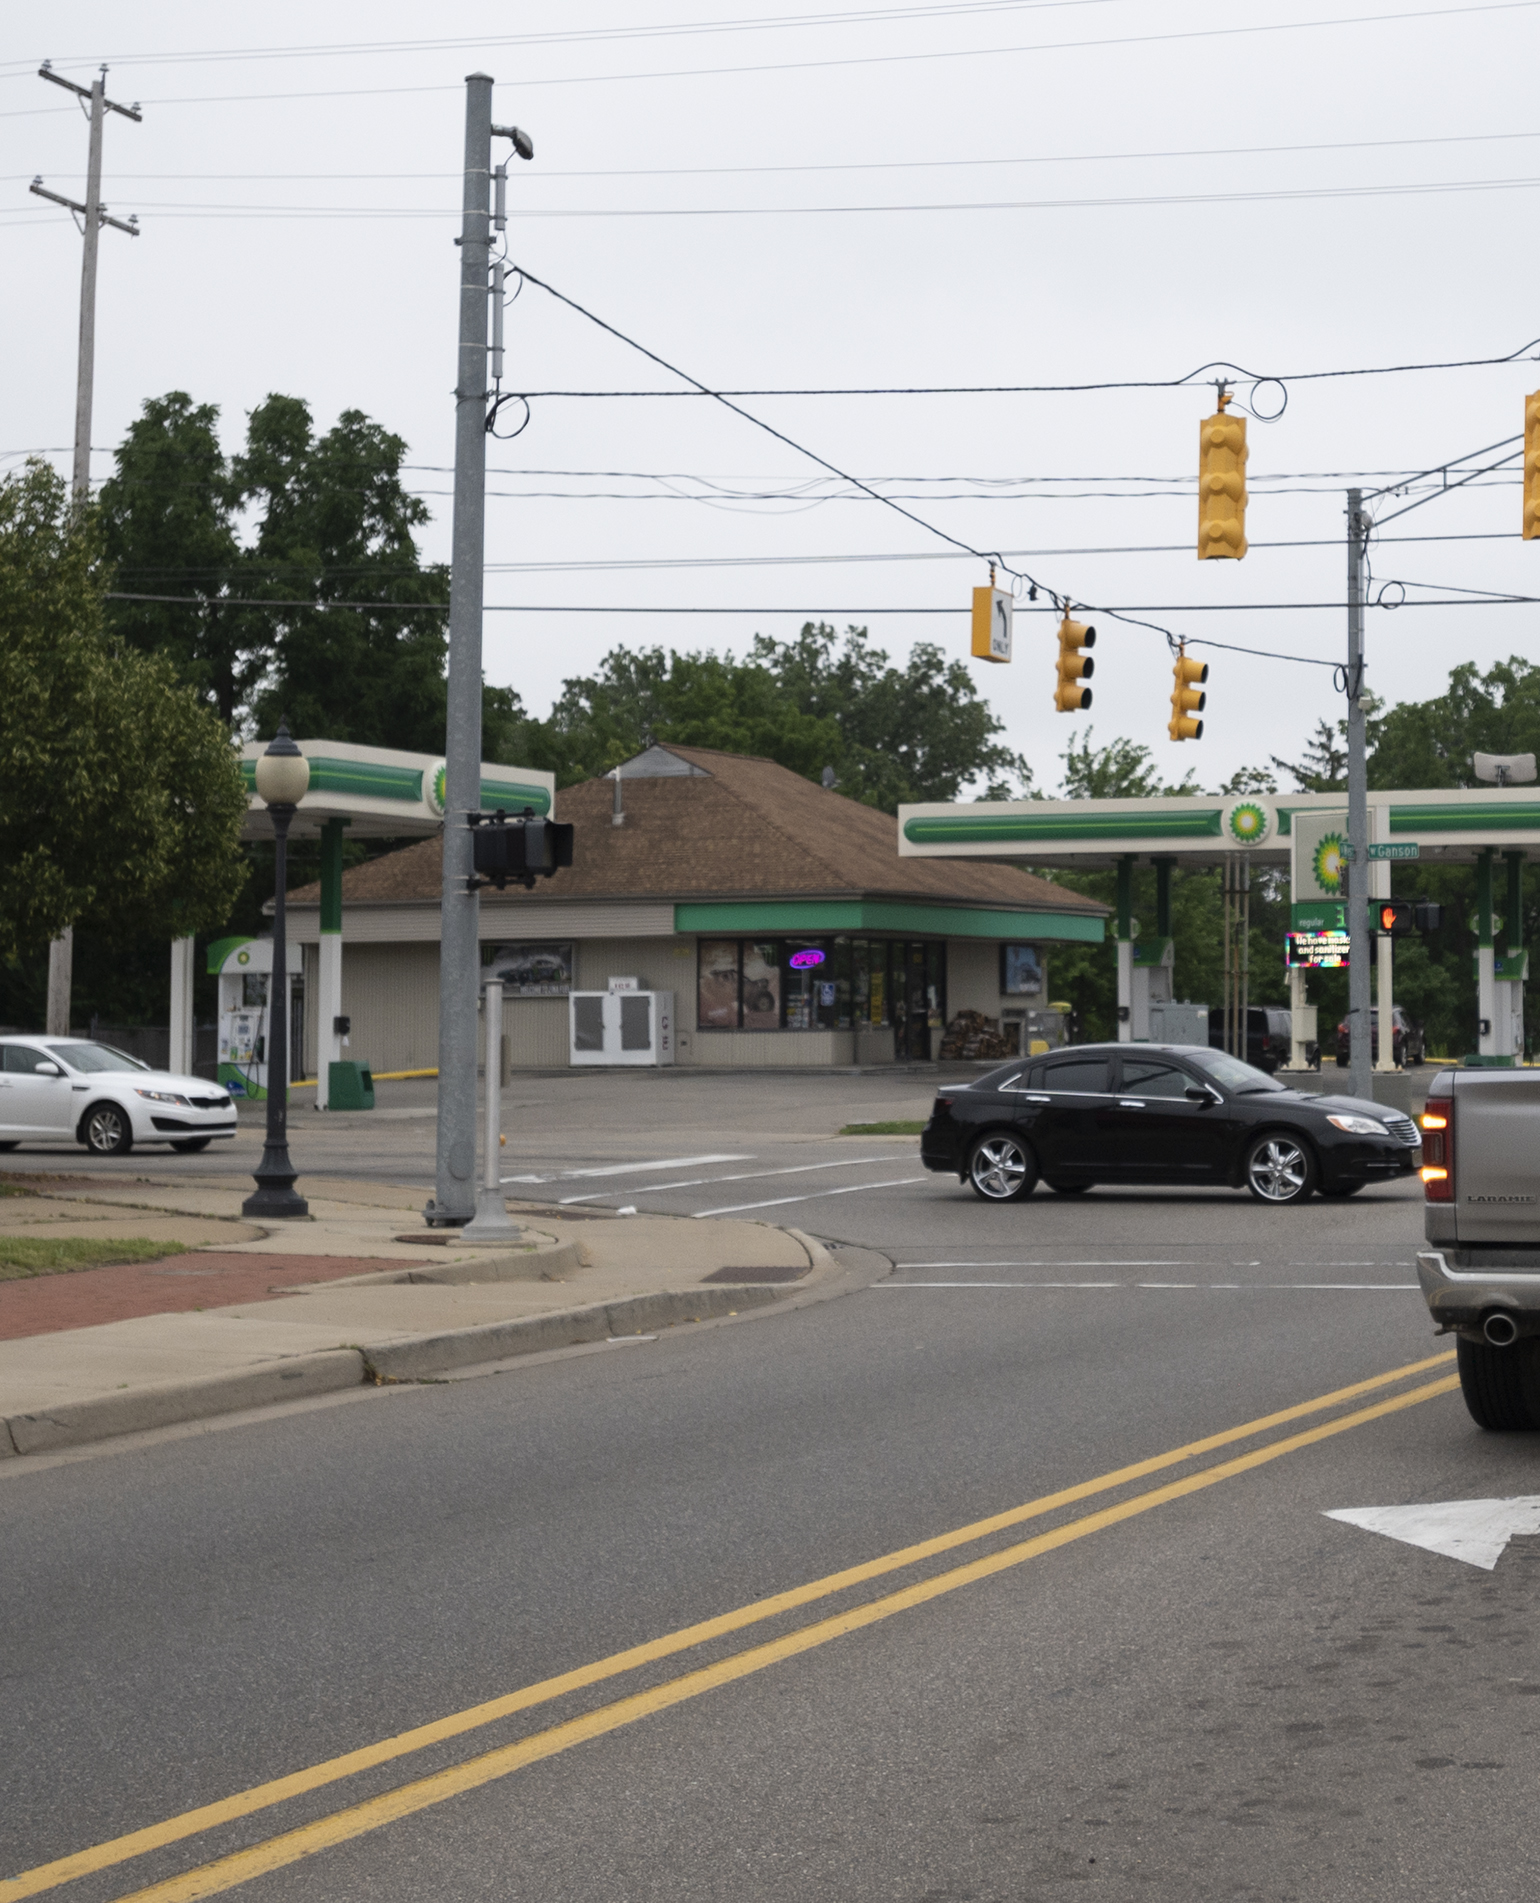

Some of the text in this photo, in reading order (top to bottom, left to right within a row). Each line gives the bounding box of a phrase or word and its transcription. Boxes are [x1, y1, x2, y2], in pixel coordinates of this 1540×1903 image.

[1378, 846, 1418, 857] Ganson
[1299, 918, 1324, 929] regular
[1296, 935, 1307, 945] We
[1308, 935, 1327, 945] have
[1297, 944, 1351, 954] and sanitizer
[793, 953, 820, 966] OPEN
[1309, 954, 1342, 963] for sale
[1467, 1195, 1535, 1203] LARAMIE
